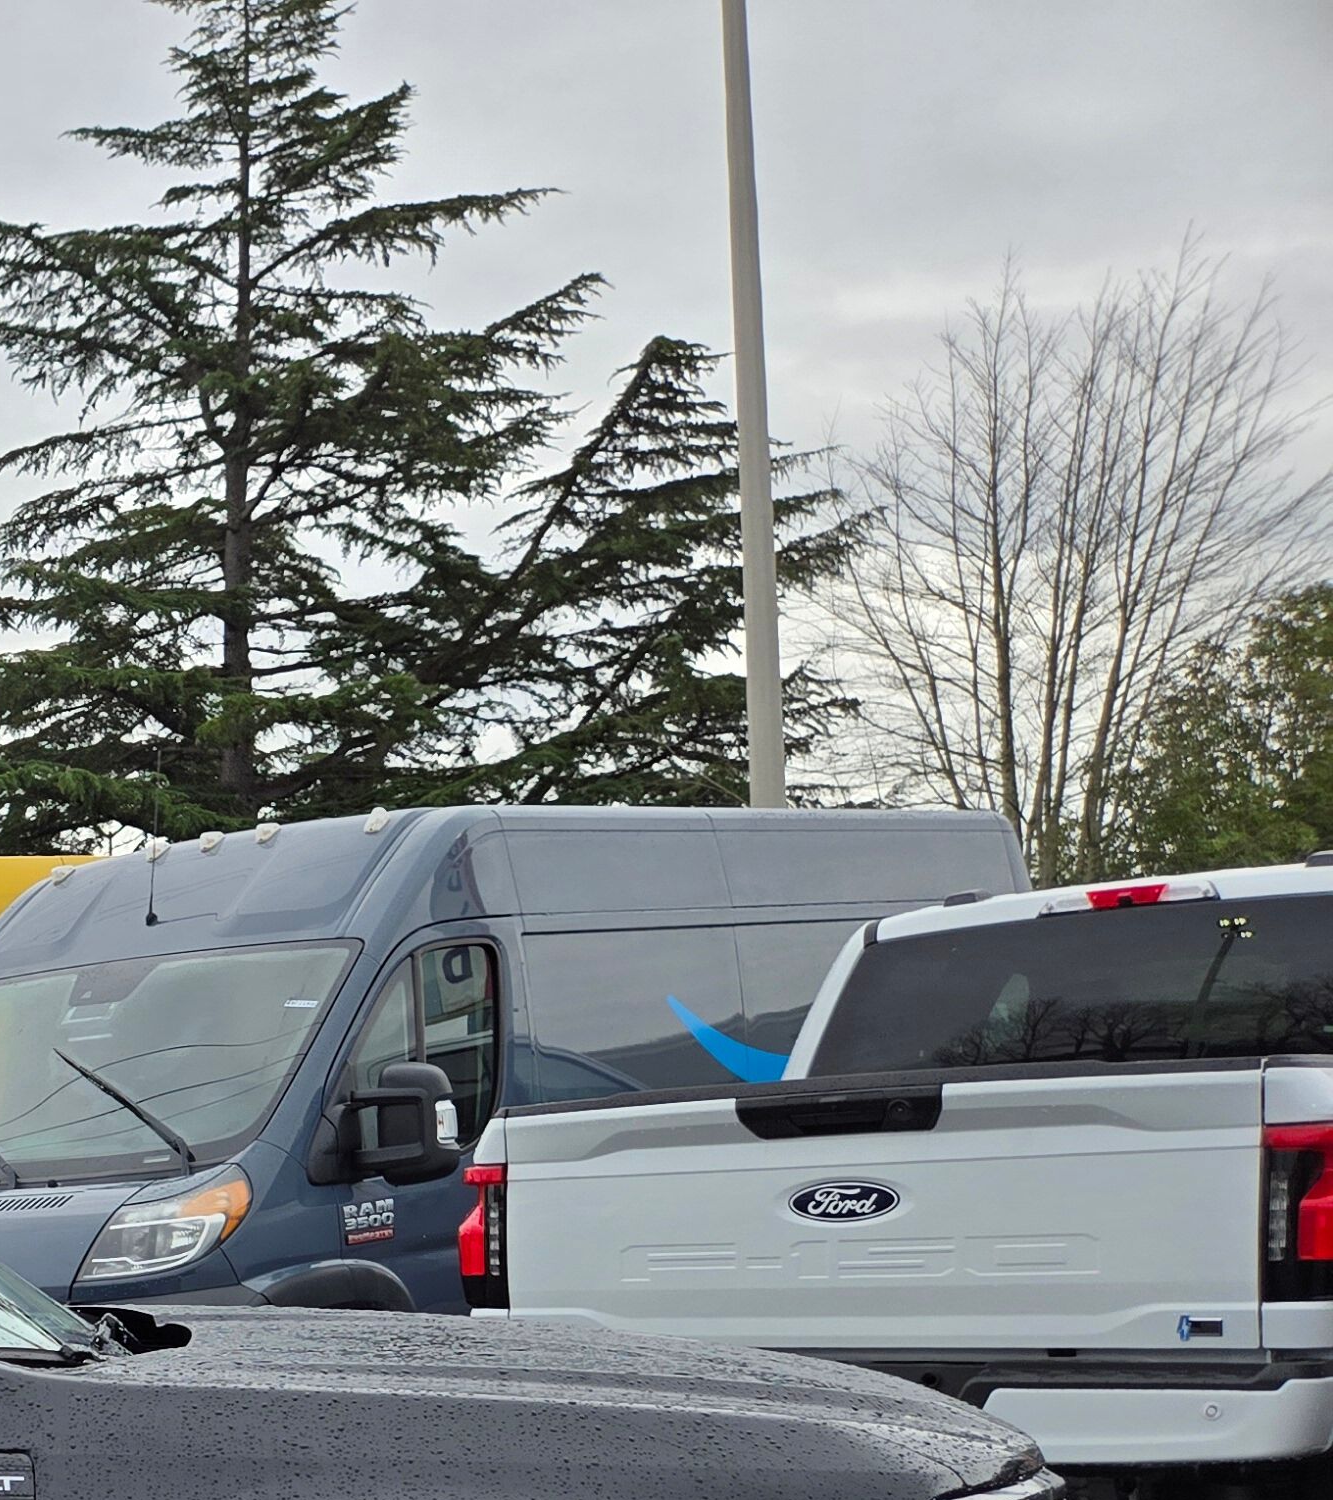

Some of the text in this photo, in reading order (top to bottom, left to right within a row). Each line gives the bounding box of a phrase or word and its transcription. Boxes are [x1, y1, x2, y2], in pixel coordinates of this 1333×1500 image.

[342, 1198, 395, 1218] RAM
[806, 1187, 879, 1216] Ford
[344, 1211, 395, 1231] 3500
[619, 1232, 1101, 1282] F-150
